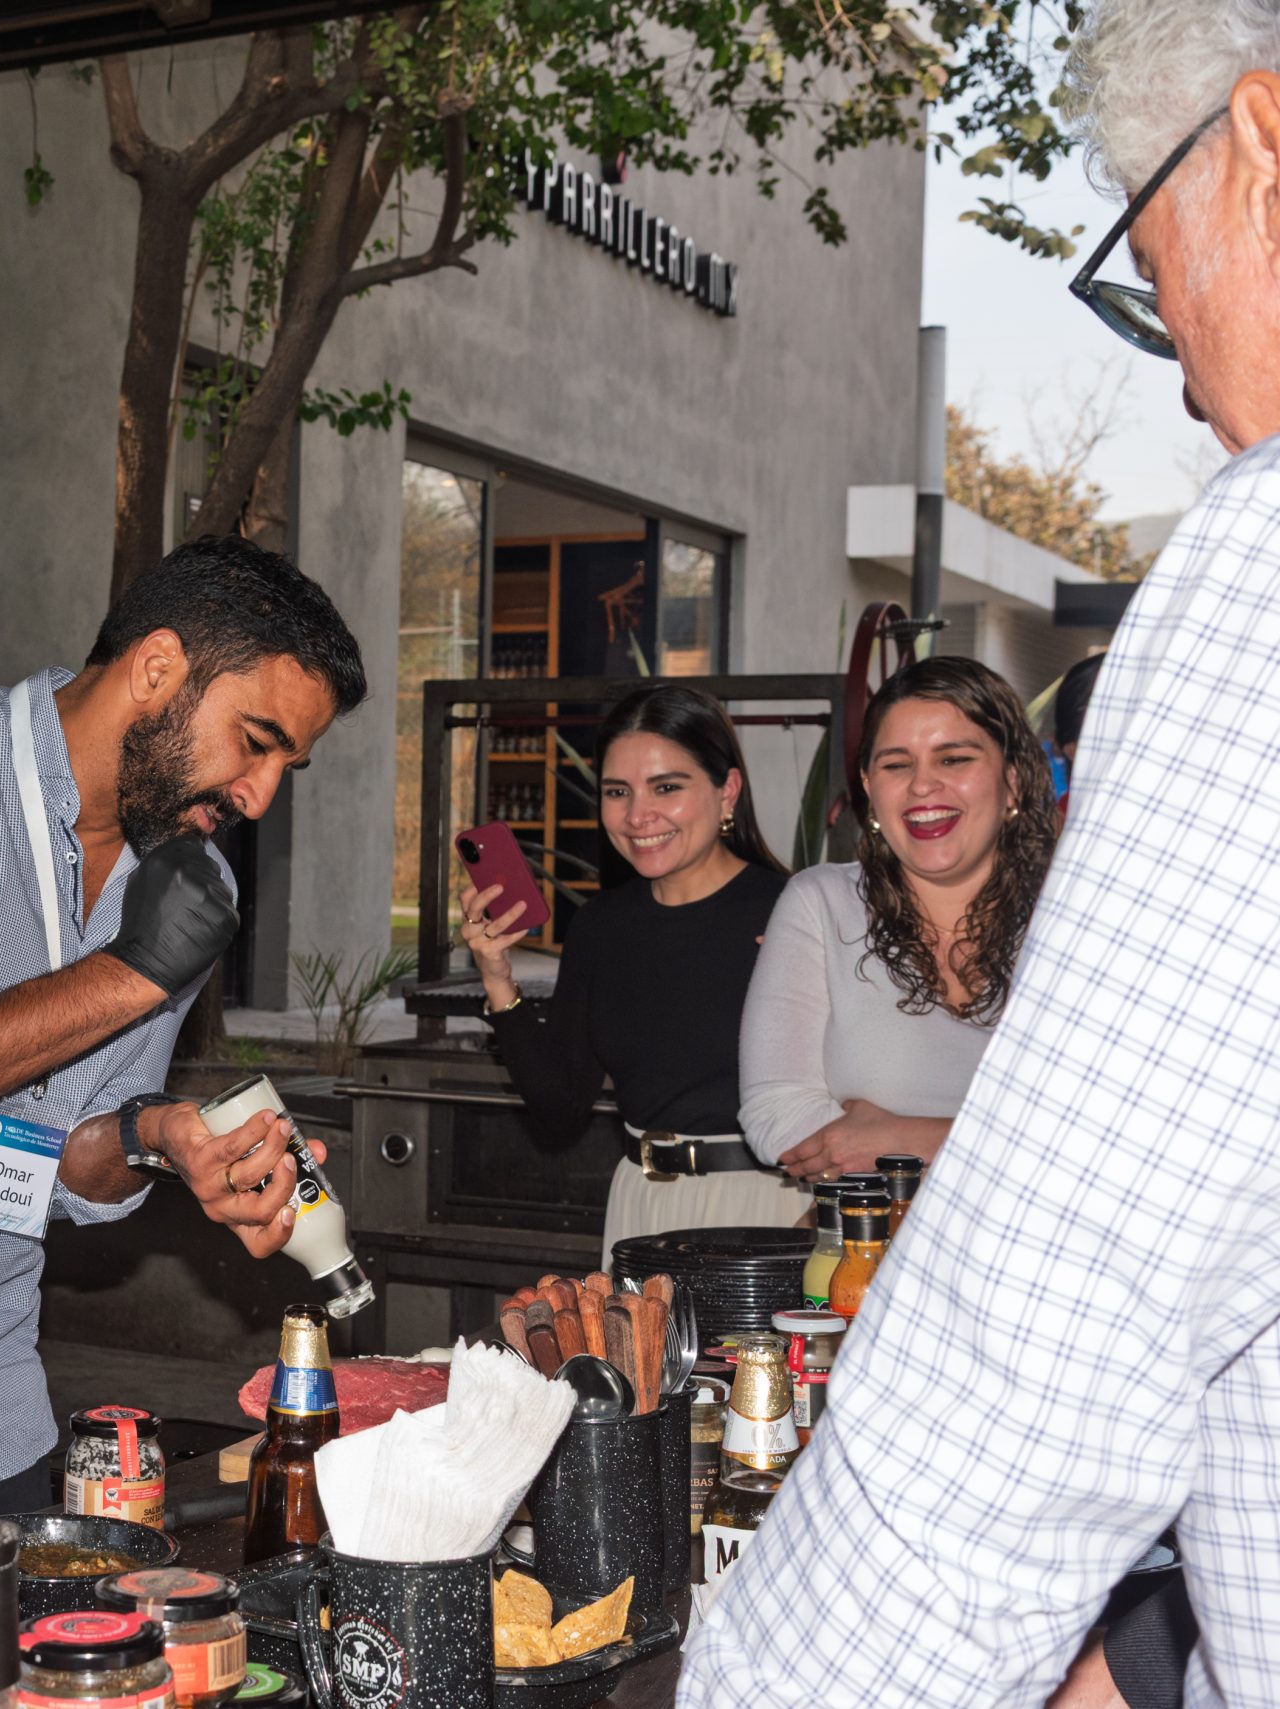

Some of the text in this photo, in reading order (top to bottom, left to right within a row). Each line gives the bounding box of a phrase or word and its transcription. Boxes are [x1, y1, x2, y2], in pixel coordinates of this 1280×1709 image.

[25, 1130, 45, 1140] Business
[46, 1134, 62, 1145] School
[748, 1455, 787, 1464] DADA
[342, 1652, 386, 1683] SMP
